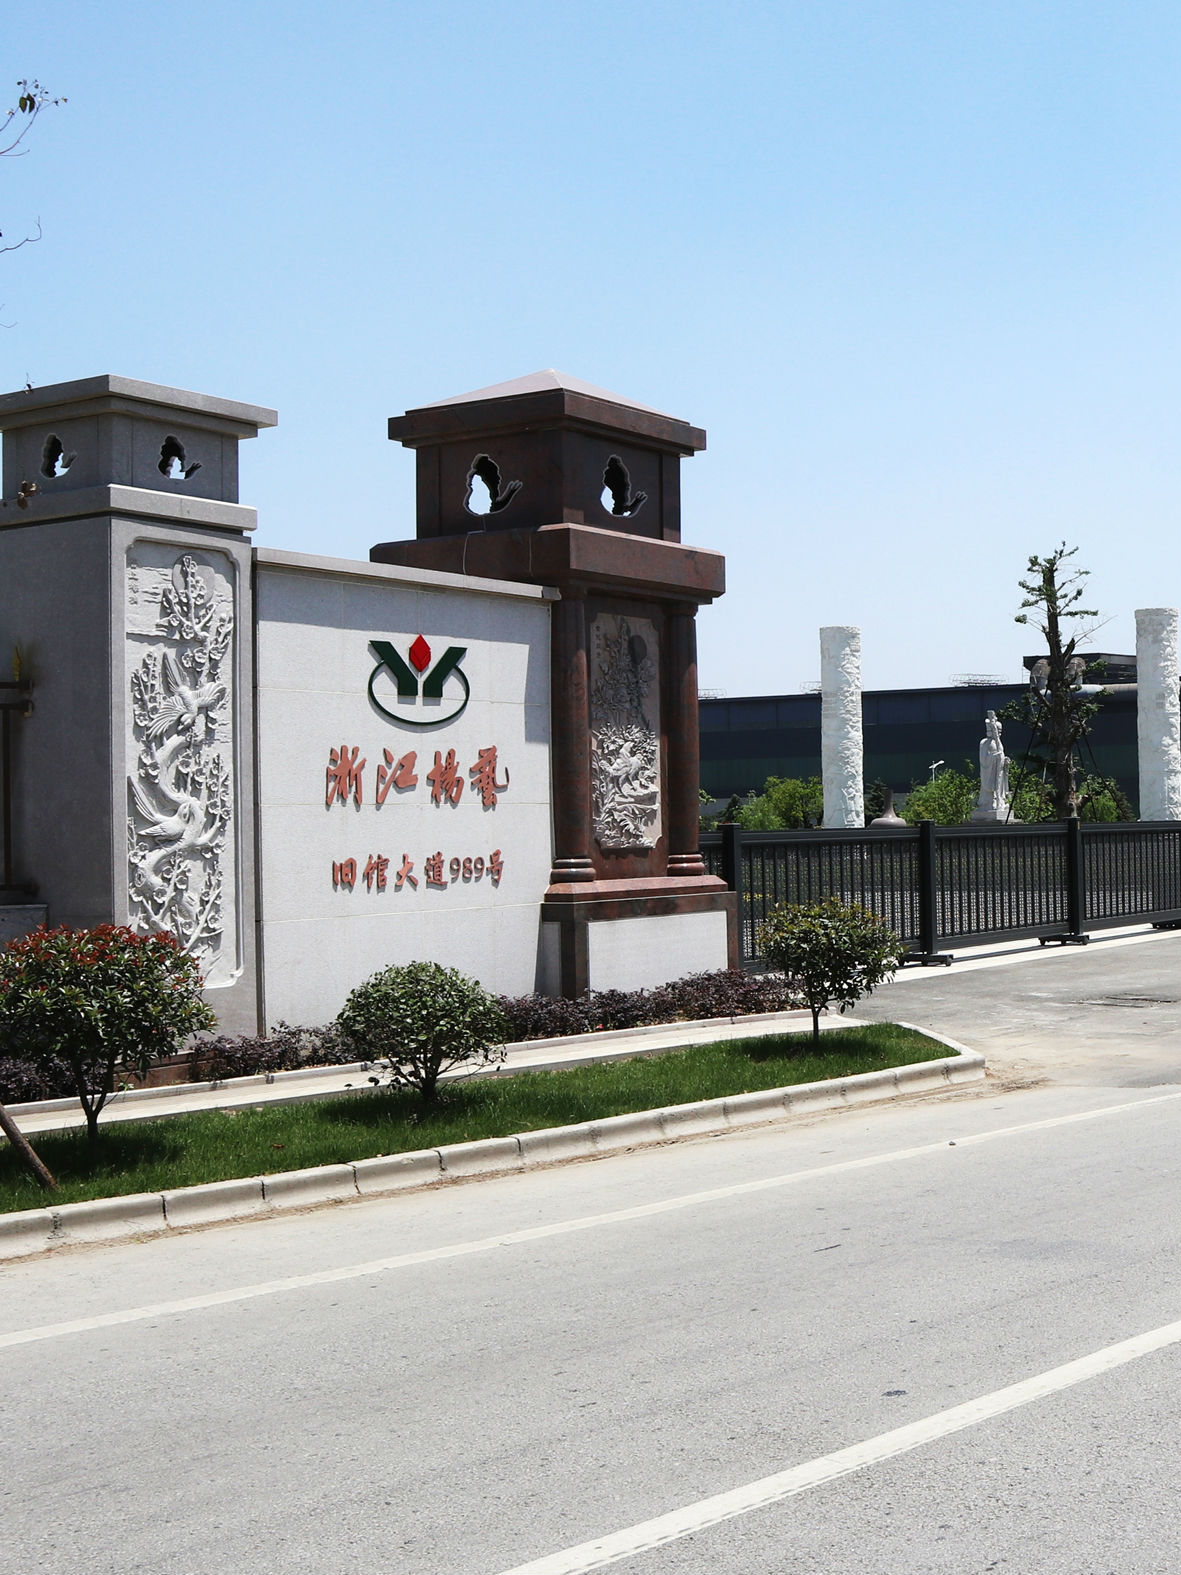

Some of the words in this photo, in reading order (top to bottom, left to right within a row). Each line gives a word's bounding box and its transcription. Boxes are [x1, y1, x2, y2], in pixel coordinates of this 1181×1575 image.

[332, 849, 505, 889] 旧馆大道989号
